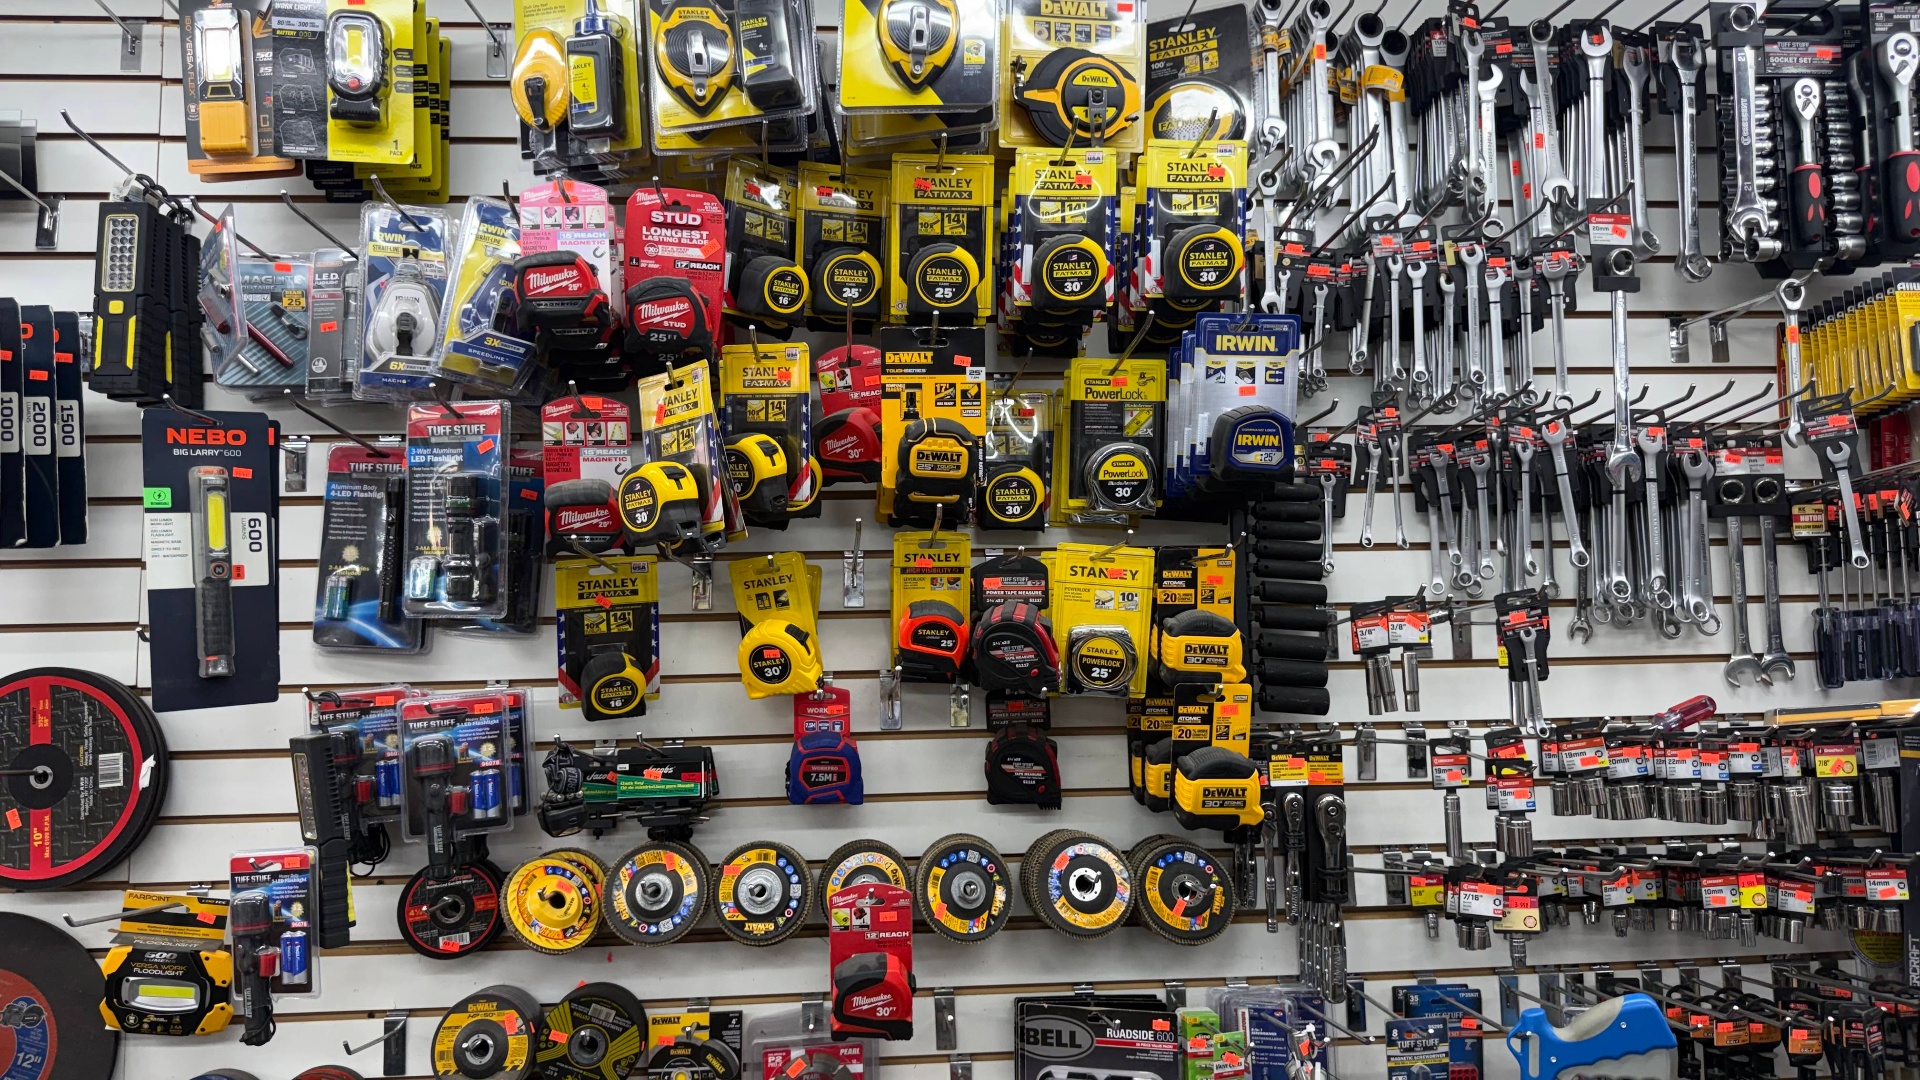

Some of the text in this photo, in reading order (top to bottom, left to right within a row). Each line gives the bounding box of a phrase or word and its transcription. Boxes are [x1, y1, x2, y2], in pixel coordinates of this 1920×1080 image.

[1149, 27, 1217, 52] STANLEY
[1156, 43, 1210, 60] FATMAX
[392, 139, 399, 150] 1
[1169, 174, 1223, 182] FATMAX
[916, 190, 972, 198] FATMAX
[650, 212, 702, 226] STUD
[642, 226, 710, 240] LONGEST
[1190, 252, 1227, 261] STANLEY
[1053, 262, 1091, 271] STANLEY
[1190, 259, 1227, 267] FATMAX
[834, 269, 868, 277] STANLEY
[926, 267, 963, 276] STANLEY
[1199, 271, 1219, 282] 30'
[527, 269, 578, 290] Milwaukee
[773, 280, 800, 290] STANLEY
[639, 302, 689, 319] Milwaukee
[650, 333, 667, 342] 25
[1216, 335, 1278, 352] IRWIN
[885, 352, 934, 364] DEWALT
[389, 362, 405, 371] 6X
[1084, 386, 1143, 400] PowerLock
[1, 397, 13, 442] 1000
[33, 402, 46, 447] 2000
[61, 405, 75, 446] 1500
[427, 424, 486, 435] TUFF STUFF
[167, 428, 247, 446] NEBO
[826, 435, 859, 449] Milwaukee
[1238, 434, 1280, 446] IRWIN
[431, 447, 463, 455] Aluminum
[426, 454, 464, 463] Flashlight
[916, 452, 963, 462] DEWALT
[1103, 469, 1145, 479] PowerLock
[362, 484, 378, 492] Body
[995, 488, 1030, 496] STANLEY
[624, 490, 651, 502] STANLEY
[561, 509, 610, 526] Milwaukee
[248, 518, 262, 553] 600
[1162, 570, 1193, 578] DEWALT
[577, 577, 639, 591] STANLEY
[743, 573, 794, 590] STANLEY
[1390, 623, 1406, 631] 3/8"
[918, 629, 950, 637] STANLEY
[1359, 628, 1376, 638] 3/8"
[1086, 647, 1119, 655] STANLEY
[1184, 644, 1229, 655] DEWALT
[753, 658, 785, 669] STANLEY
[1082, 657, 1122, 667] POWERLOCK
[764, 666, 782, 677] 30'
[600, 685, 632, 693] STANLEY
[1177, 705, 1208, 714] DEWALT
[409, 719, 456, 729] TUFF STUFF
[474, 719, 500, 727] Flashlight
[1564, 750, 1586, 759] 19mm
[1608, 757, 1630, 766] 20mm
[1668, 758, 1687, 766] 22mm
[1818, 759, 1830, 767] 7/8"
[1202, 787, 1247, 798] DEWALT
[1204, 800, 1223, 808] 30'
[33, 827, 43, 847] 10"
[235, 874, 272, 884] TUFF STUFF
[1412, 889, 1425, 897] 3/8"
[1604, 886, 1618, 894] 8mm
[1703, 888, 1724, 896] 10mm
[128, 893, 171, 902] FARPOINT
[831, 893, 859, 905] Milwaukee
[1463, 892, 1484, 901] 7/16"
[880, 930, 909, 938] REACH
[130, 961, 187, 971] VERSA WORK
[133, 967, 184, 976] FLOODLIGHT
[851, 994, 893, 1010] Milwaukee
[1409, 994, 1420, 1002] 35
[467, 1003, 498, 1011] DEWALT
[651, 1016, 681, 1026] DEWALT
[1106, 1027, 1175, 1042] ROADSIDE 600
[1391, 1028, 1399, 1037] 8
[1027, 1029, 1084, 1049] BELL
[1397, 1038, 1440, 1049] TUFF STUFF
[16, 1053, 42, 1070] 12"
